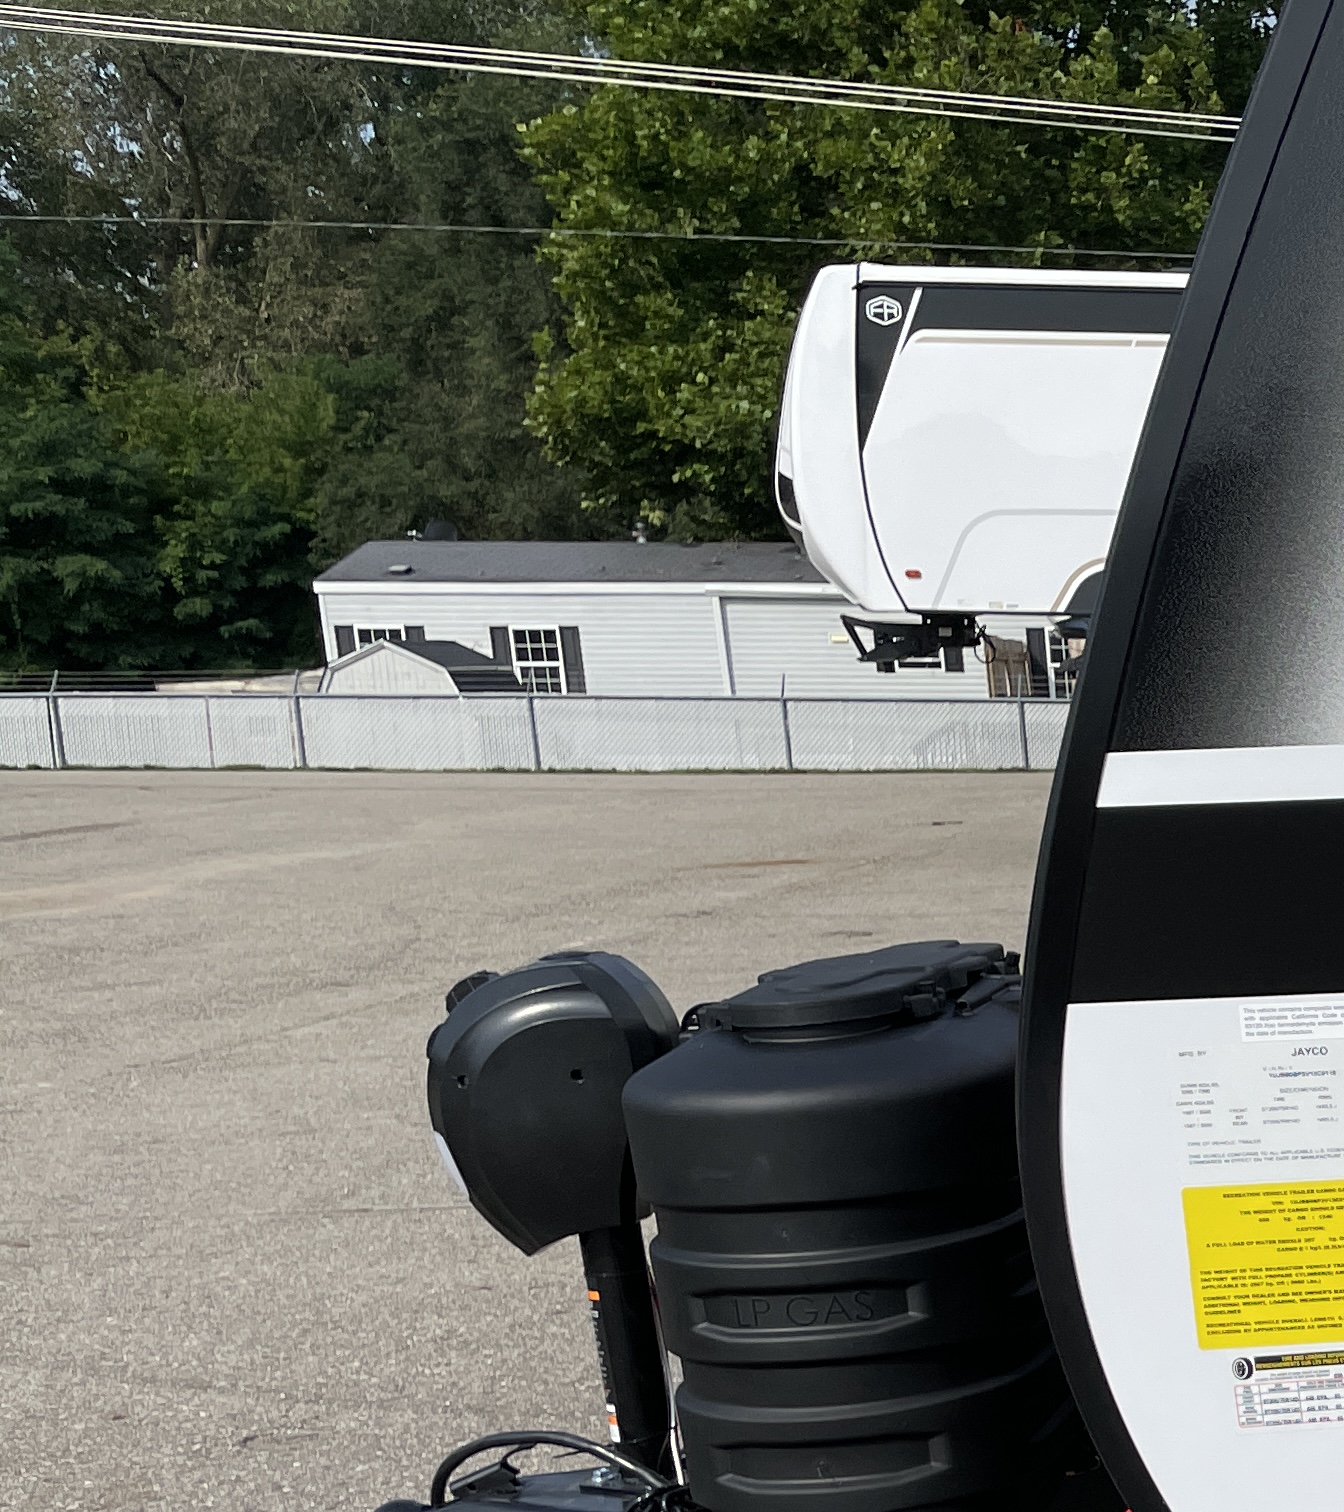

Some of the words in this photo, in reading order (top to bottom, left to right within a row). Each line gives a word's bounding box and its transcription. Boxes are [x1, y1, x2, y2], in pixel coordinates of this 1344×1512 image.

[1289, 1046, 1329, 1056] JAYCO
[735, 1297, 770, 1326] LP
[786, 1290, 874, 1326] GAS
